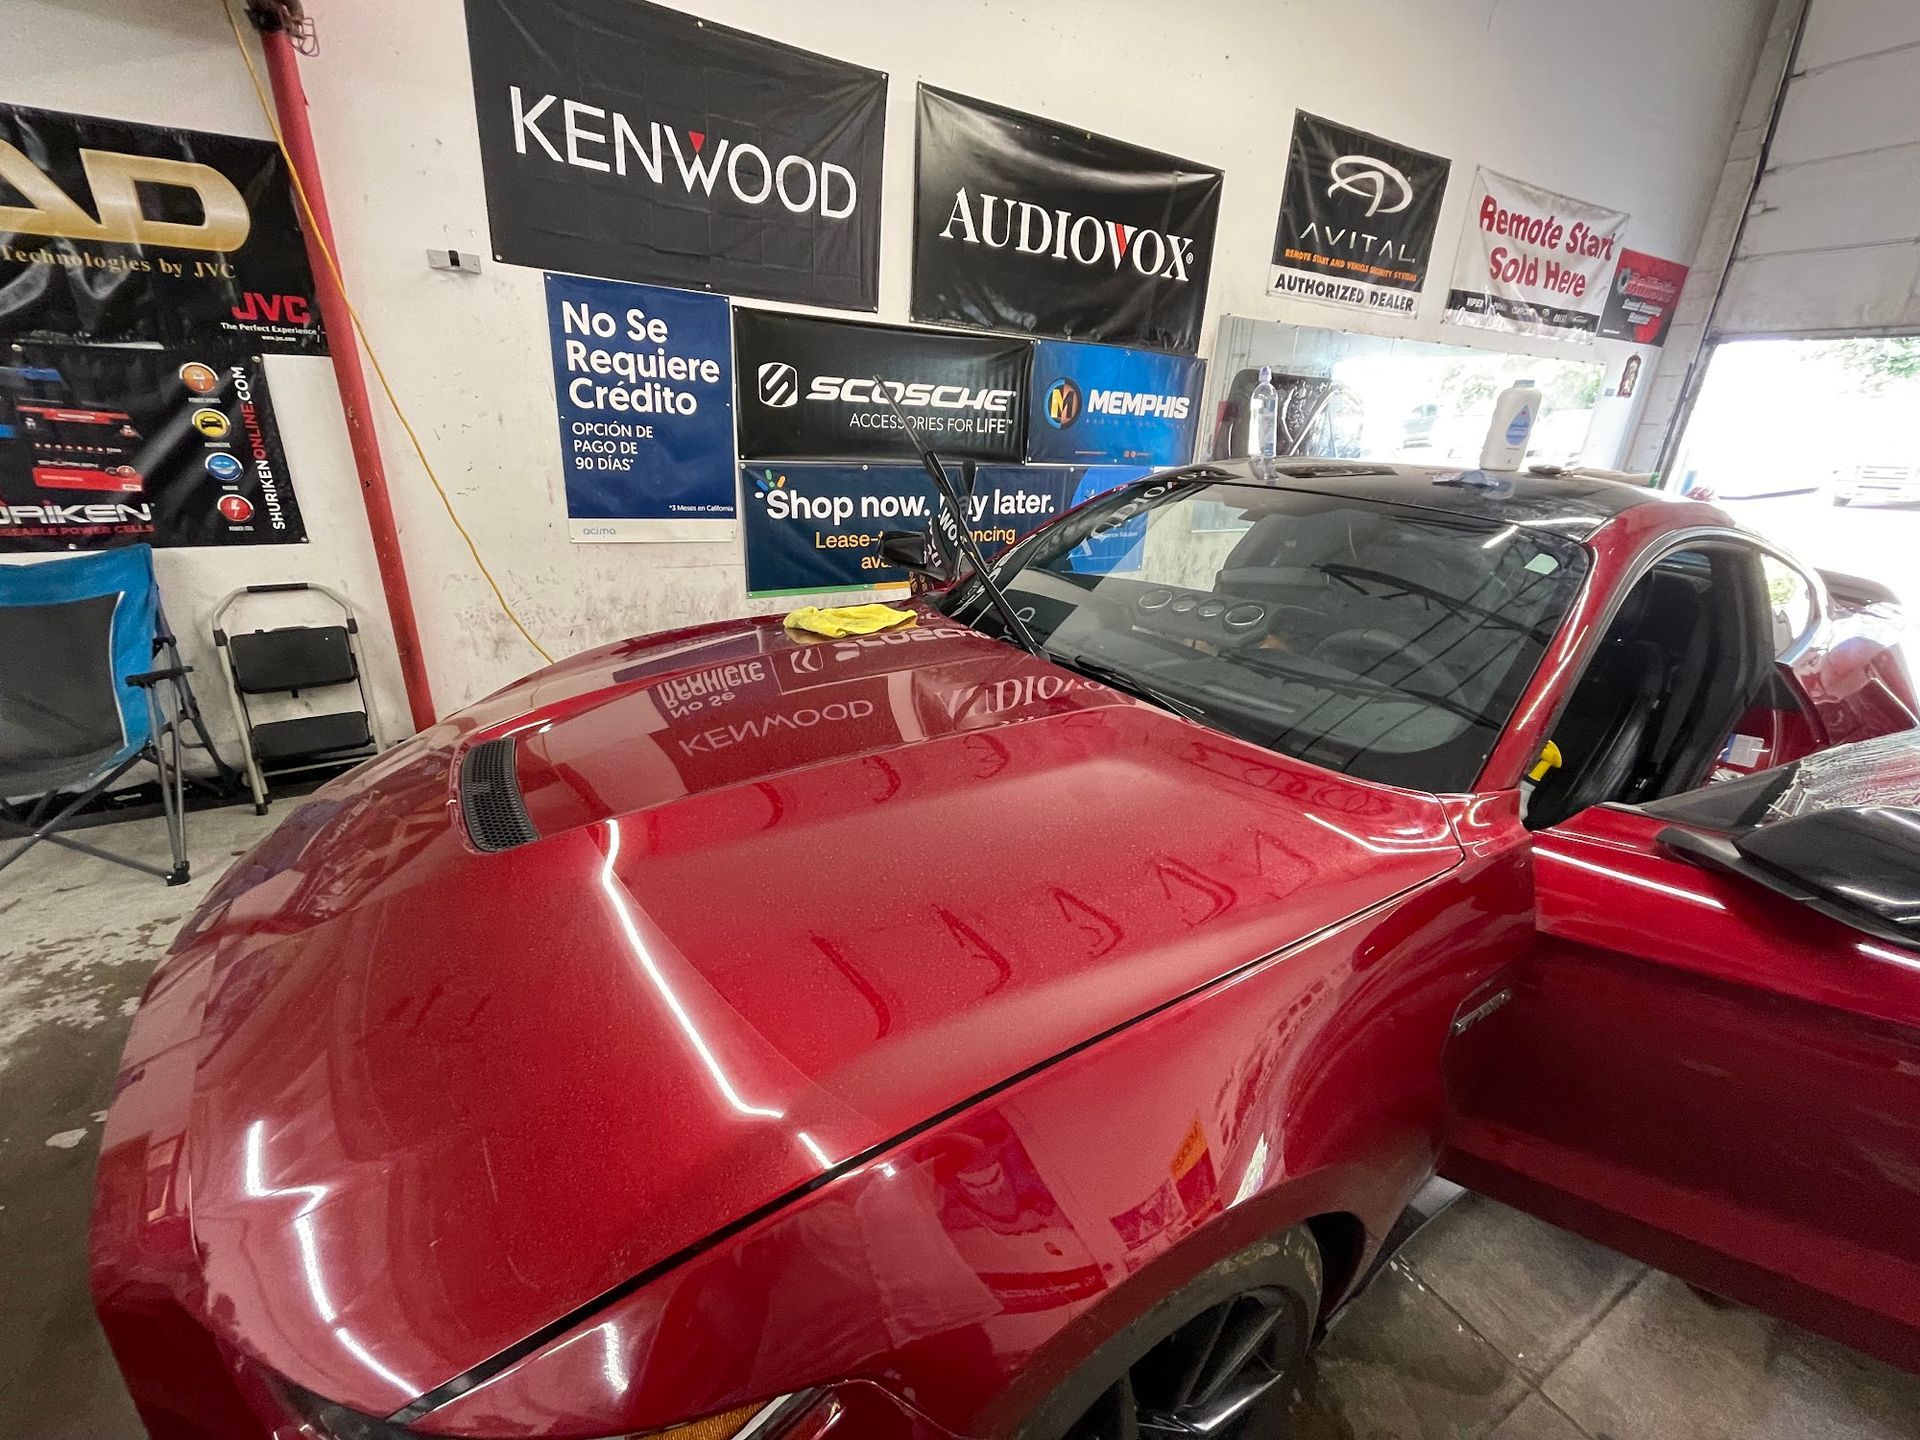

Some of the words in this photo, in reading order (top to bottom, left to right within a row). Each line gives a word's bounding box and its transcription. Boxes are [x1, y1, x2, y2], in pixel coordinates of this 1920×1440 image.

[509, 86, 857, 219] KENWOOD
[1479, 195, 1564, 249] Remote
[1565, 221, 1616, 261] Start
[2, 245, 151, 273] Technologies
[160, 258, 183, 279] by
[194, 261, 237, 279] JVC
[1330, 258, 1346, 269] AND
[1489, 247, 1539, 287] Sold
[1543, 260, 1587, 297] Here
[231, 292, 311, 324] JVC
[1274, 273, 1365, 304] AUTHORIZED
[1369, 290, 1414, 312] DEALER
[220, 322, 238, 331] The
[239, 323, 270, 333] Perfect
[271, 325, 318, 336] Experience
[561, 300, 617, 338] No
[626, 308, 668, 344] Se
[565, 340, 721, 384] Requiere
[569, 377, 698, 416] Crédito
[1087, 389, 1191, 419] MEMPHIS
[571, 421, 632, 437] OPCIÓN
[636, 425, 654, 438] DE
[947, 417, 973, 432] FOR
[231, 366, 286, 530] SHURIKENONLINE.COM
[573, 440, 617, 453] PAGO
[620, 441, 638, 454] DE
[575, 457, 594, 469] 90
[766, 488, 854, 525] Shop
[860, 494, 931, 518] now.
[993, 488, 1055, 515] later.
[582, 526, 617, 536] acima
